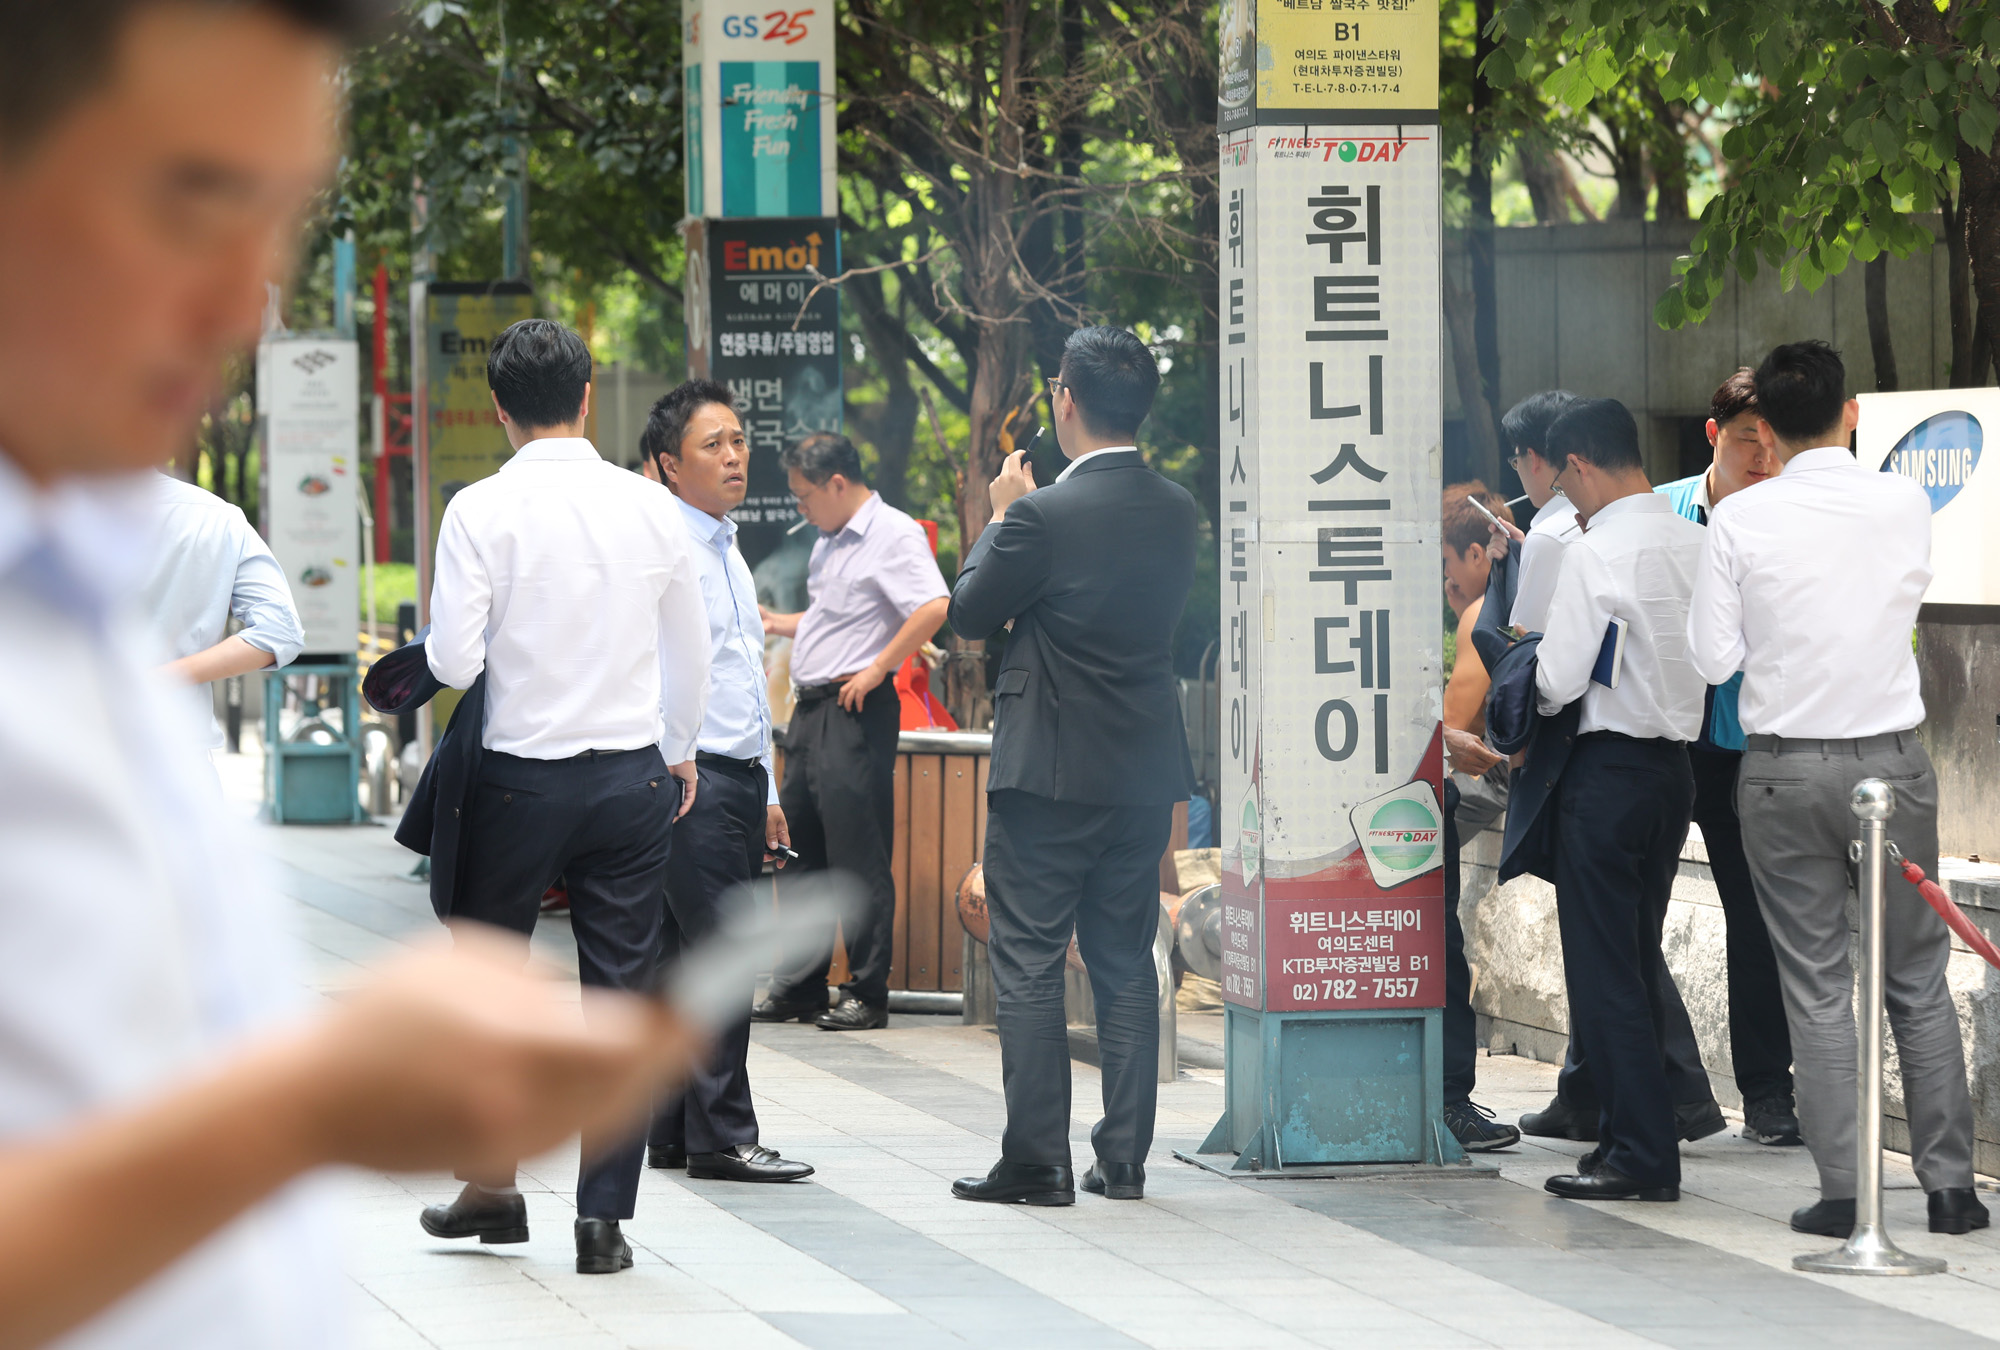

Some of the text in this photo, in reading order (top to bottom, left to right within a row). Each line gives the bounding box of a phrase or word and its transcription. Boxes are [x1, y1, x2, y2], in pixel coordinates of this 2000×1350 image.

[723, 8, 815, 45] GS25
[1334, 22, 1360, 42] B1
[1294, 49, 1401, 61] 여의도 파이낸스타워
[1293, 65, 1403, 78] (현대차투자증권빌딩)
[732, 82, 809, 111] Friendly
[744, 109, 798, 132] Fresh
[751, 135, 790, 158] Fun
[1889, 448, 1972, 488] SAMSUNG
[1290, 909, 1421, 934] 휘트니스투데이
[1317, 935, 1394, 953] 여의도센터
[1282, 955, 1429, 974] KTB투자증권빌딩 B1
